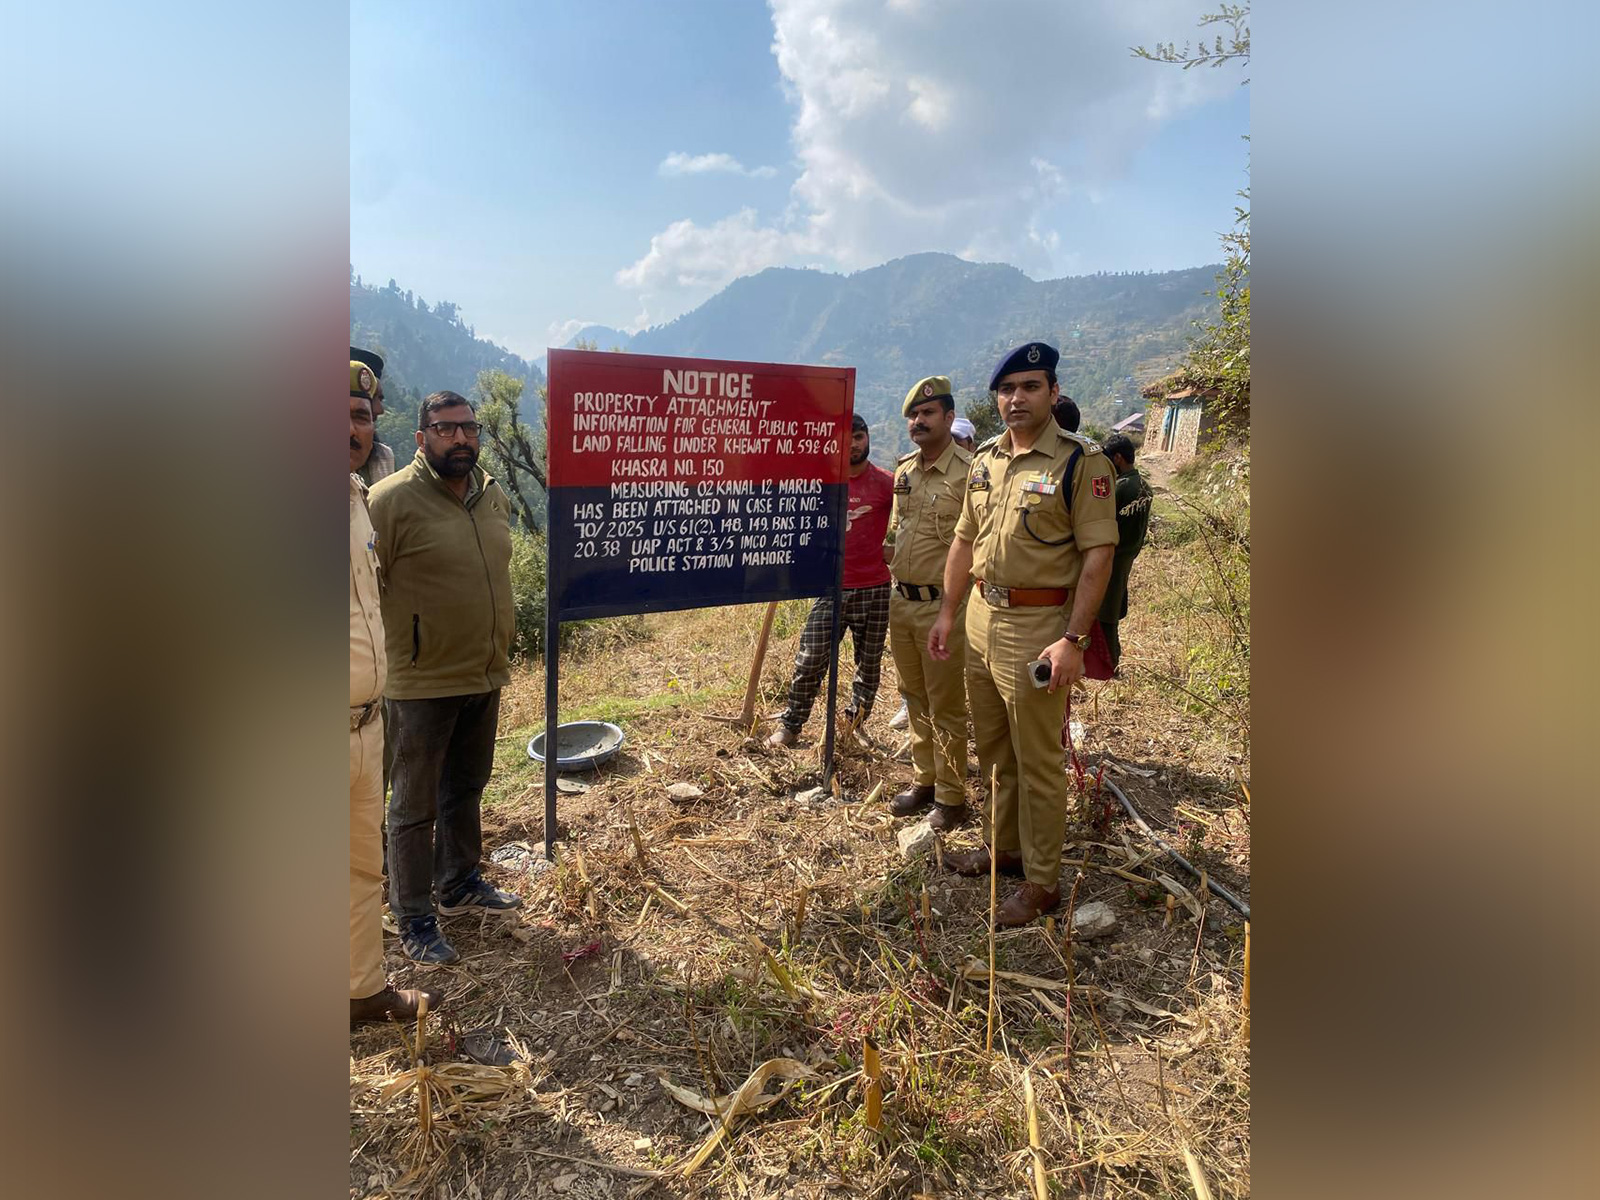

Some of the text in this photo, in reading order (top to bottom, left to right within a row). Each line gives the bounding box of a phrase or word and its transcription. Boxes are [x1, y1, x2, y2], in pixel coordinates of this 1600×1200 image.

[662, 369, 754, 398] NOTICE
[573, 391, 772, 418] PROPERTY ATTACHMENT
[573, 413, 836, 437] INFORMATION FOR GENERAL PUBLIC THAT
[572, 434, 612, 453] LAND
[616, 435, 667, 454] FALLING
[672, 436, 717, 454] UNDER
[723, 437, 772, 455] KHEWAT
[611, 457, 668, 477] KHASRA
[702, 458, 725, 477] 150
[610, 480, 690, 499] MEASURING
[716, 479, 756, 496] KANAL
[761, 478, 773, 495] 12
[778, 478, 823, 495] MARLAS
[573, 503, 604, 520] HAS
[612, 500, 649, 519] BEEN
[727, 498, 740, 514] IN
[745, 497, 773, 514] CASE
[778, 496, 797, 513] FIR
[653, 519, 677, 536] U/S
[631, 538, 662, 556] UAP
[666, 537, 693, 554] ACT
[709, 534, 736, 552] 3/5
[740, 534, 767, 550] IMCO
[771, 532, 796, 548] ACT
[799, 531, 814, 547] OF
[629, 555, 677, 573] POLICE
[681, 553, 735, 571] STATION
